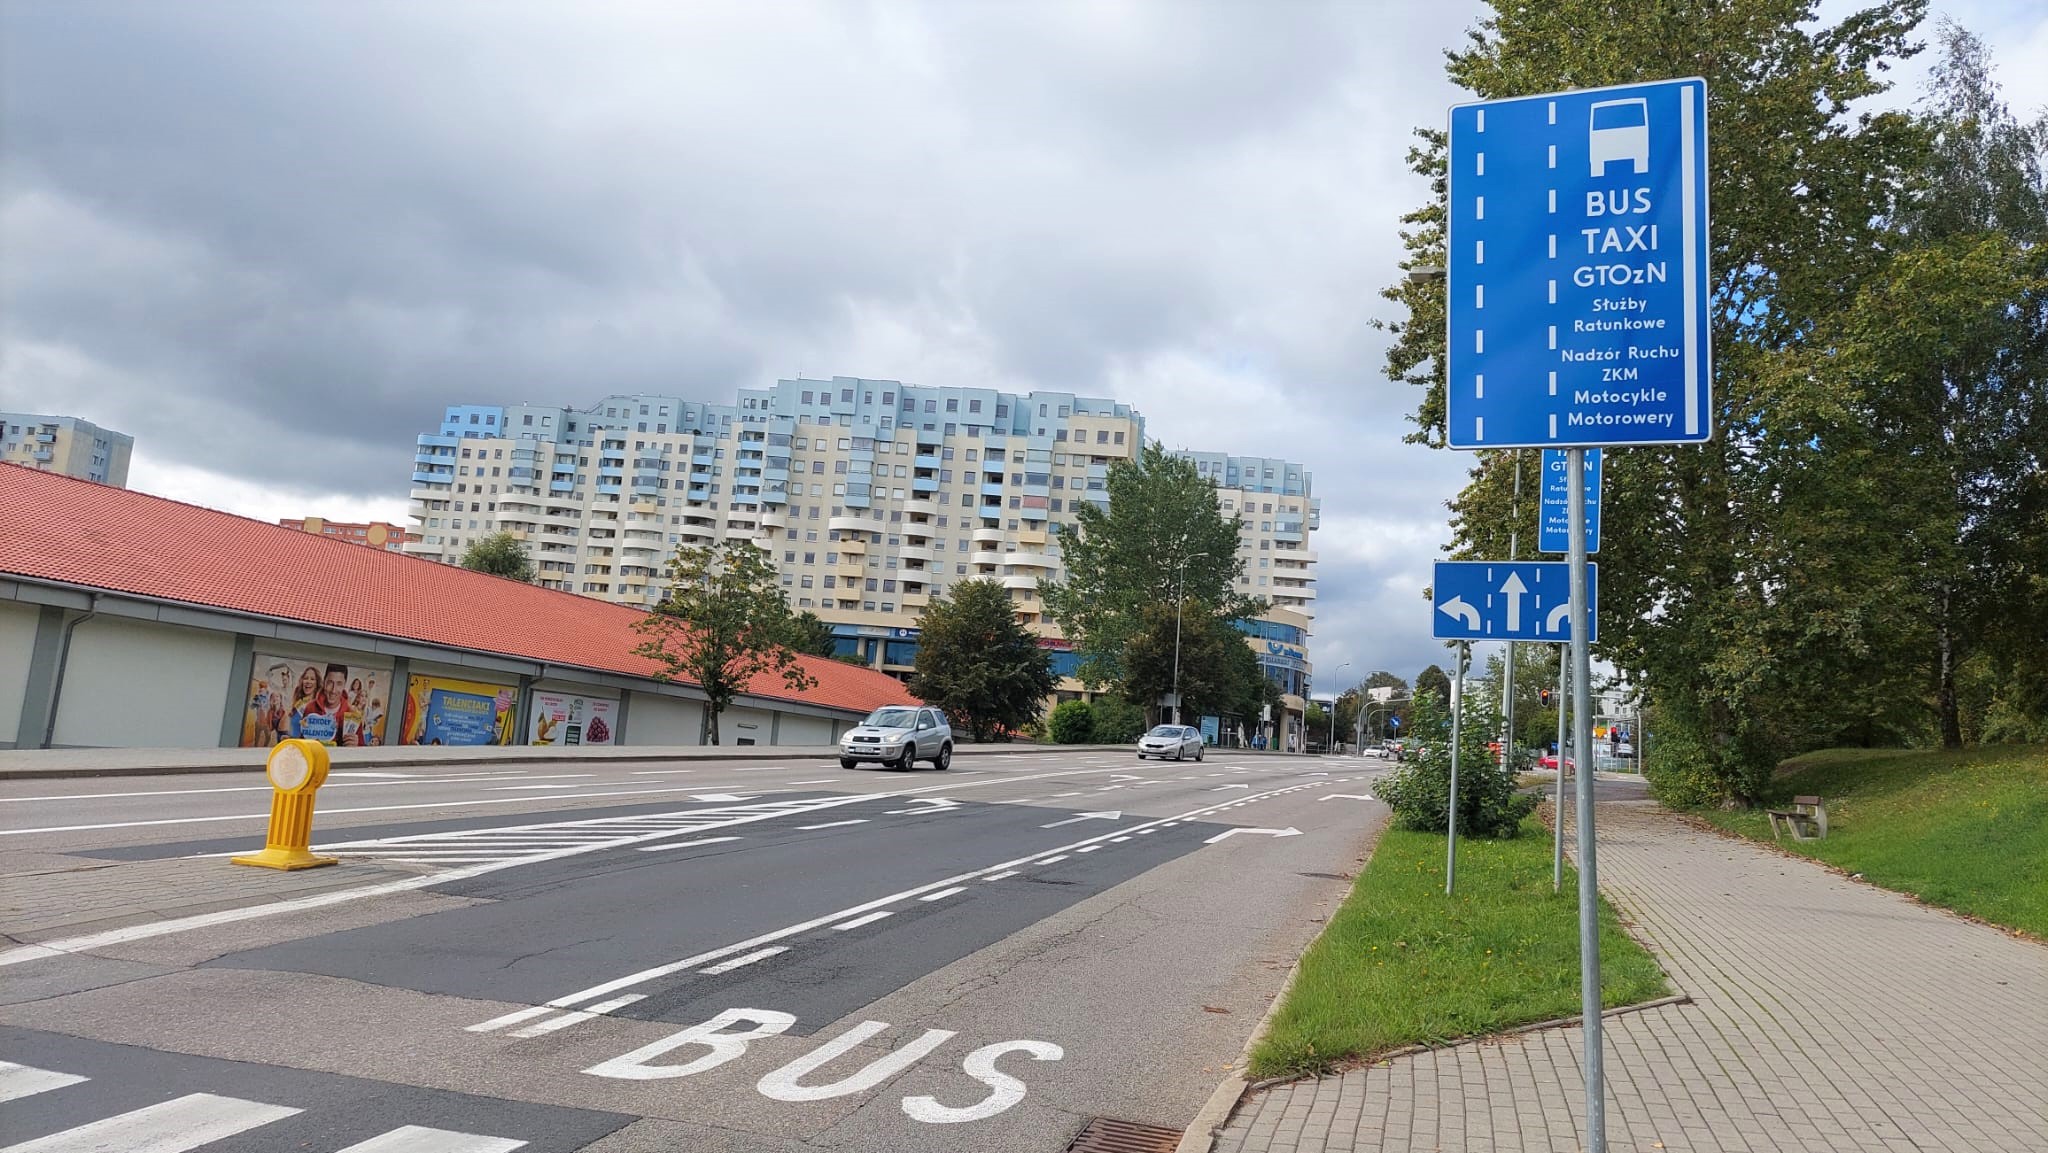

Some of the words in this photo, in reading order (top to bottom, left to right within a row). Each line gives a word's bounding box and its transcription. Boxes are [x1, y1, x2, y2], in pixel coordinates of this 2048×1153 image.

[1586, 187, 1652, 217] BUS
[1581, 224, 1658, 254] TAXI
[1573, 261, 1667, 287] GTOzN
[1592, 297, 1647, 313] Służby
[1574, 317, 1666, 333] Ratunkowe
[1561, 347, 1621, 362] Nadzór
[1628, 344, 1680, 360] Ruchu
[1601, 367, 1638, 382] ZKM
[1574, 387, 1667, 407] Motocykle
[1568, 412, 1674, 428] Motorowery
[1550, 461, 1593, 472] GTN
[580, 1007, 1065, 1124] BUS
